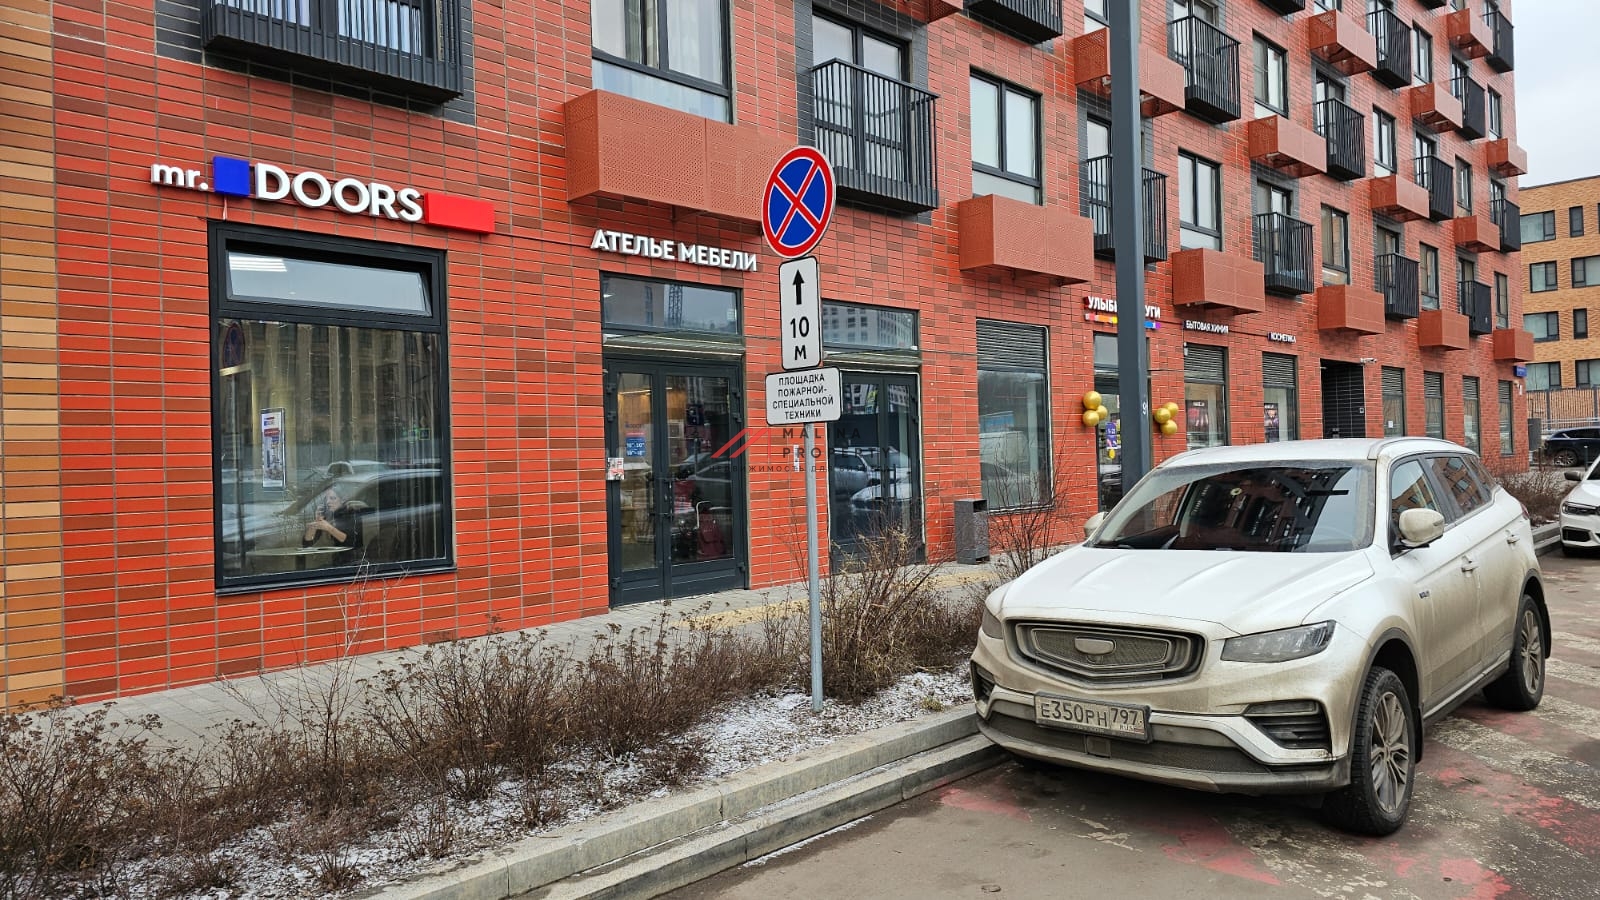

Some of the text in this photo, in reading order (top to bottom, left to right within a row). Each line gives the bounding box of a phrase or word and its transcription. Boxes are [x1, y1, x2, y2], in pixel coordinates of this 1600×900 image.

[151, 162, 423, 222] mr. DOORS
[590, 229, 758, 272] АТЕЛЬЕ МЕБЕЛИ
[790, 316, 810, 339] 10
[1185, 319, 1229, 334] БЫТОВАЯ ХИМИЯ
[794, 344, 807, 361] М
[777, 384, 827, 398] ПОЖАРНОЙ-
[772, 394, 834, 409] СПЕЦИАЛЬНОЙ
[784, 409, 821, 420] ТЕХНИКИ
